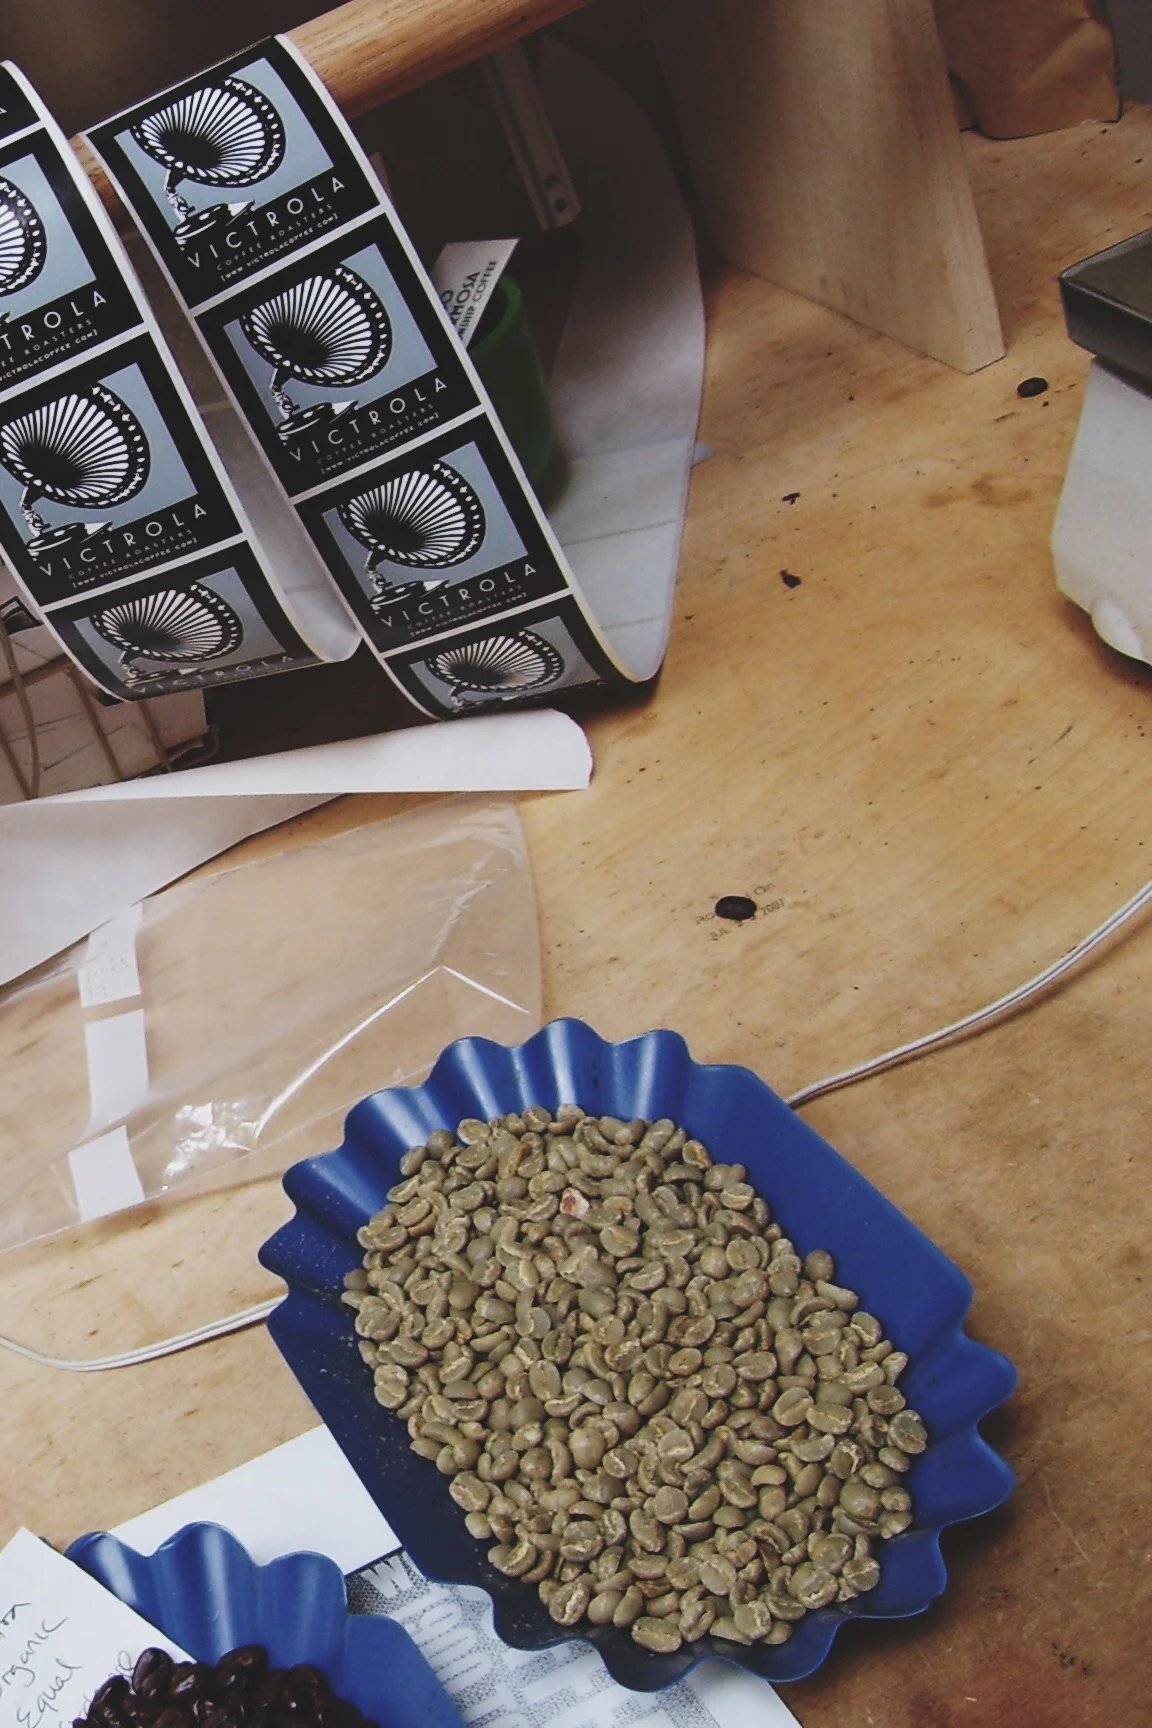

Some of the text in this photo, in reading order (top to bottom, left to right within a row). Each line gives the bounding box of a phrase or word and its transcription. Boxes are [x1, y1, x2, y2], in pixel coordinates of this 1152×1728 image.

[187, 176, 345, 268] VICTROLA
[216, 203, 333, 271] COFFEE ROASTERS
[472, 260, 497, 302] COFFEE
[24, 319, 92, 356] ROASTERS
[289, 377, 447, 461] VICTROLA
[316, 403, 434, 465] COFFEE ROASTERS
[39, 503, 207, 576] VICTROLA
[69, 528, 193, 580] COFFEE ROASTERS
[380, 563, 536, 627] VICTROLA
